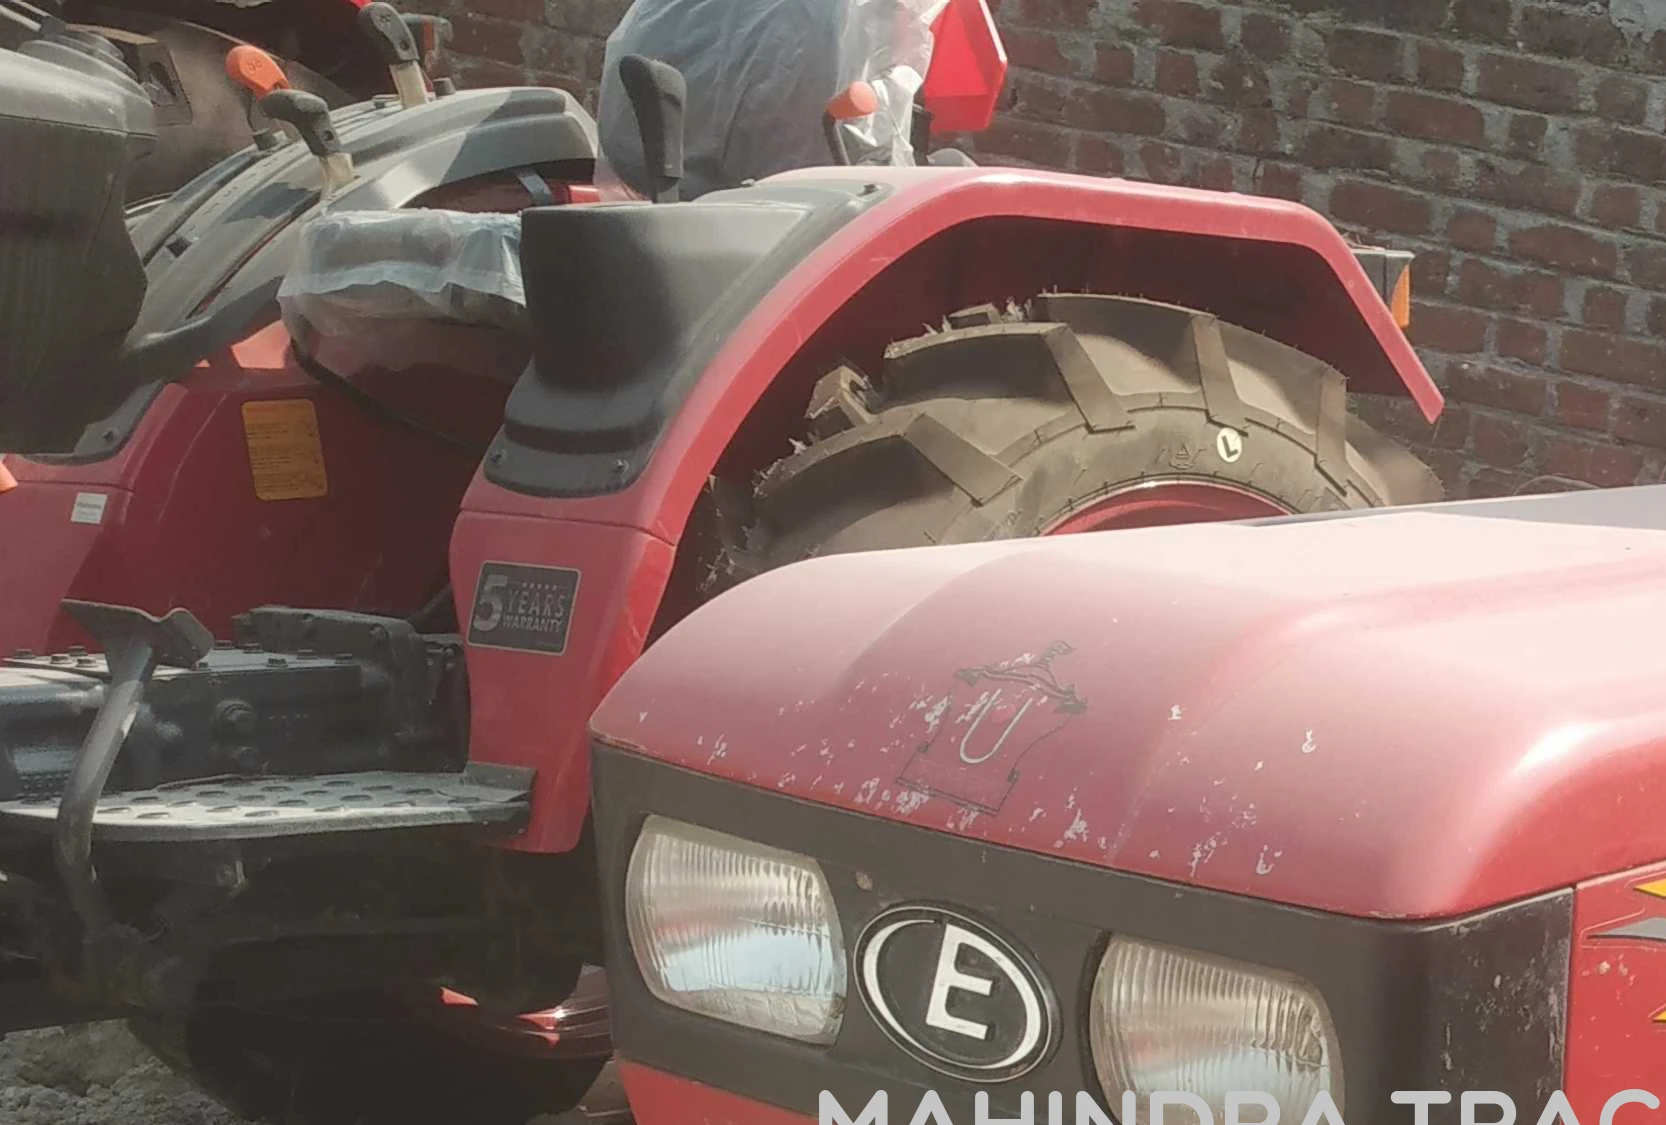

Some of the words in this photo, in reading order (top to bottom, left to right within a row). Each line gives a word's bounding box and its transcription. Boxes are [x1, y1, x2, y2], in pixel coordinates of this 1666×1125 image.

[473, 574, 508, 632] 5
[507, 590, 569, 618] YEARS
[503, 613, 565, 633] WARRANTY
